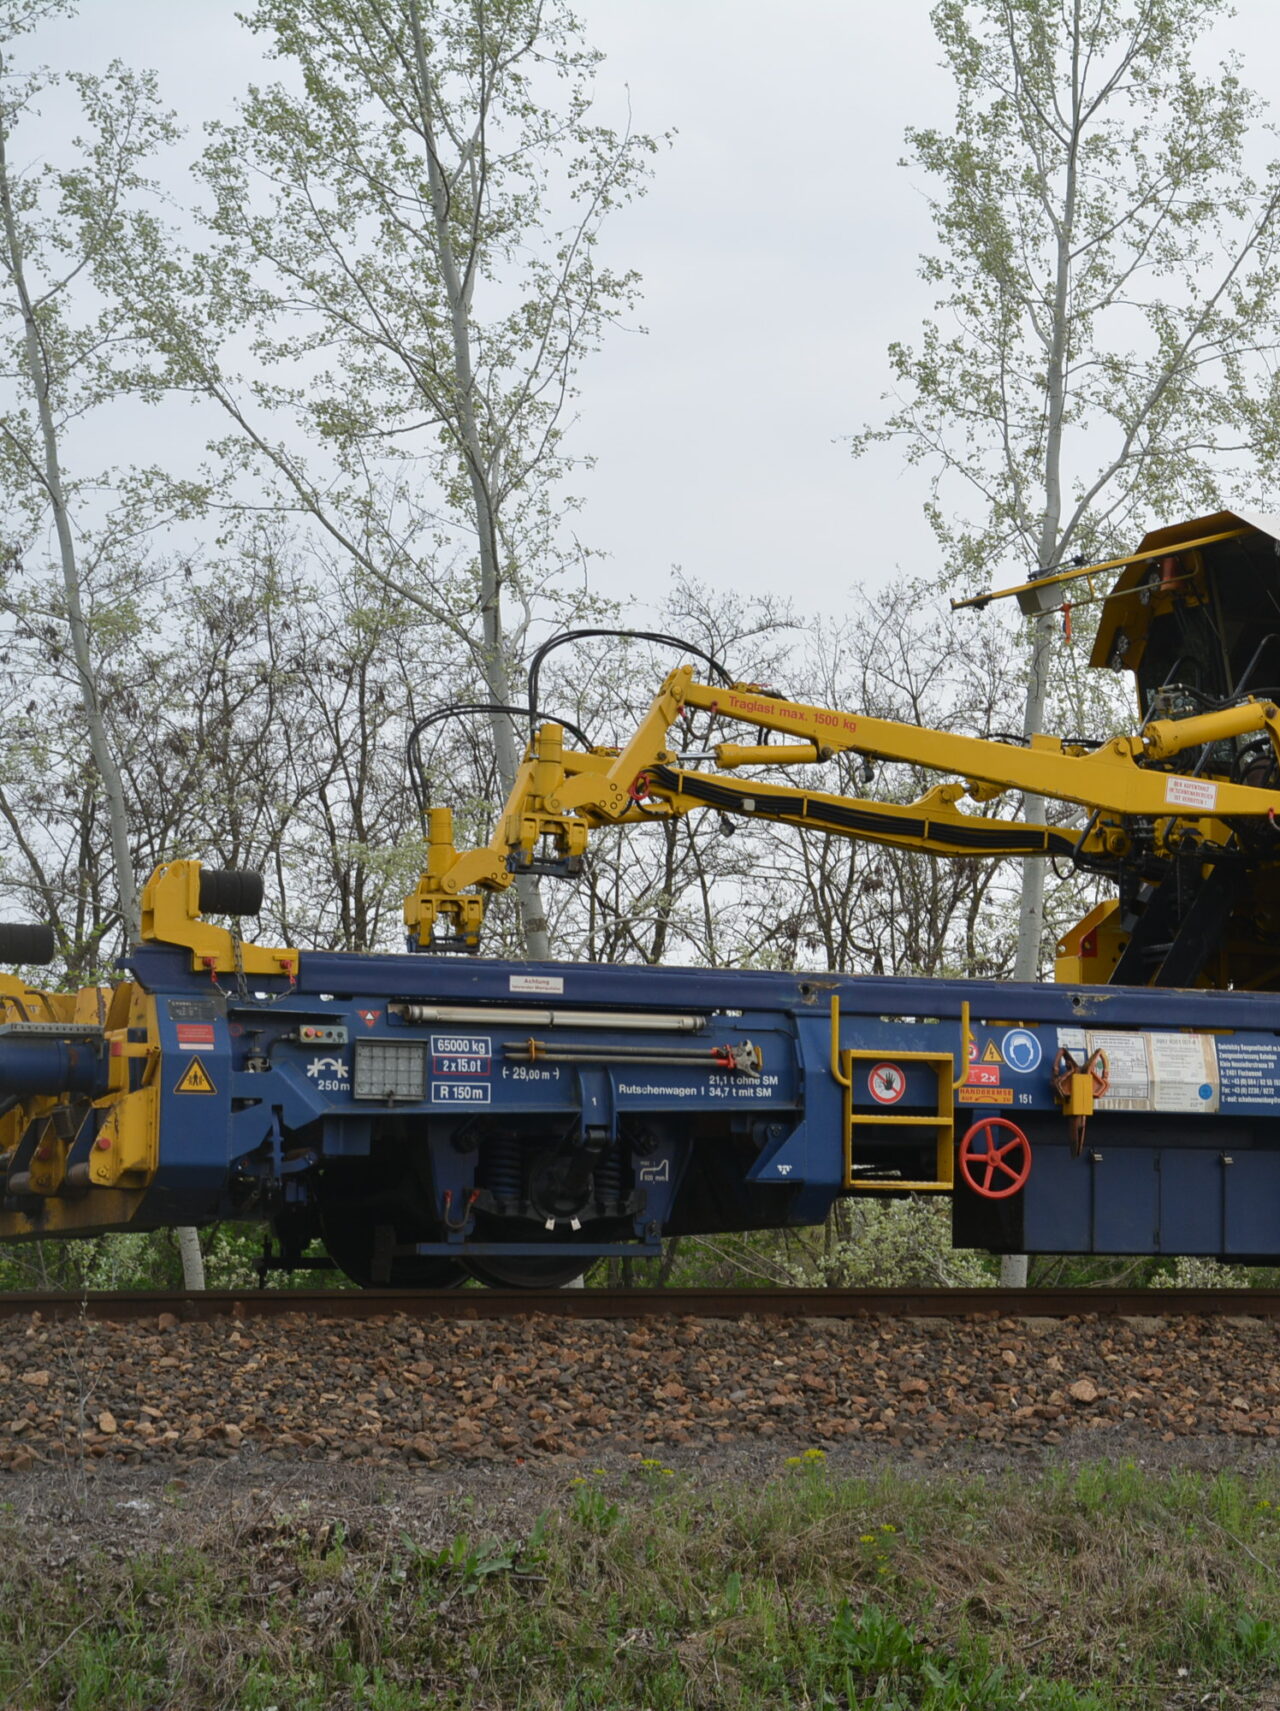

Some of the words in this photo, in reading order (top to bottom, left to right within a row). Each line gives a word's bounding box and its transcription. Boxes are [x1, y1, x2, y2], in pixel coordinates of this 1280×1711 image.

[729, 696, 774, 715] Traglast
[780, 708, 808, 721] max.
[814, 713, 838, 727] 1500
[843, 719, 856, 732] kg
[438, 1040, 468, 1051] 65000
[472, 1041, 485, 1054] kg
[709, 1076, 728, 1086] 21,1
[730, 1076, 734, 1085] t
[736, 1076, 760, 1085] ohne
[762, 1076, 778, 1085] SM
[440, 1086, 448, 1098] R
[619, 1084, 697, 1097] Rutschenwagen
[709, 1087, 728, 1098] 34,7
[732, 1088, 736, 1096] t
[738, 1088, 754, 1096] mit
[756, 1088, 772, 1097] SM
[960, 1088, 1012, 1096] HANDBREMSE
